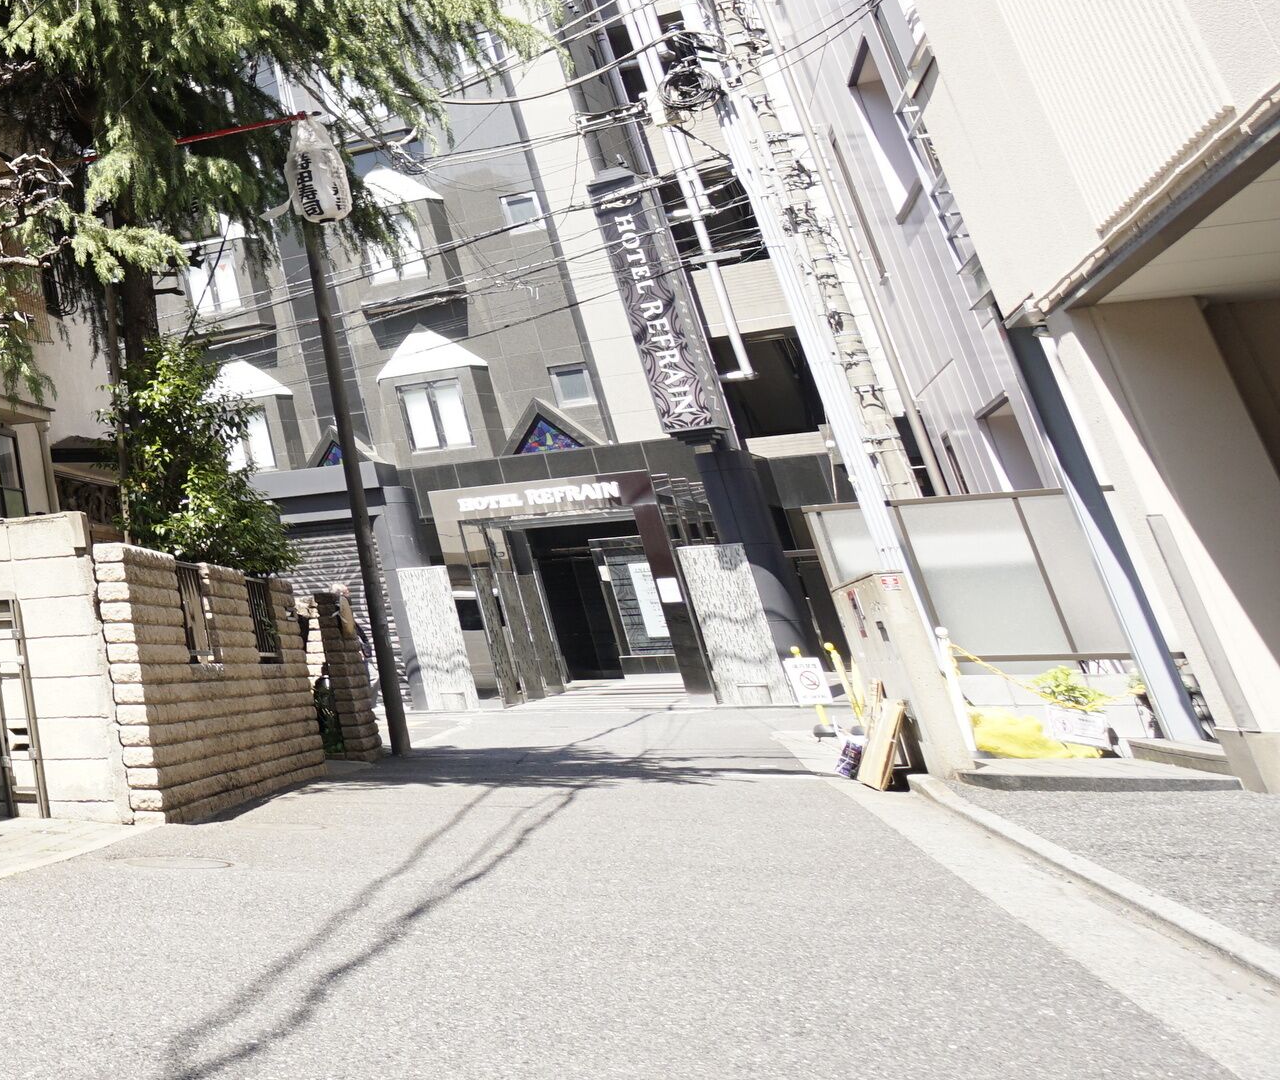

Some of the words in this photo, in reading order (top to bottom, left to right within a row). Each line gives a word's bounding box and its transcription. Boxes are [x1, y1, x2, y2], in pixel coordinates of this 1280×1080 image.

[614, 213, 656, 295] HOTEL
[640, 298, 699, 416] REFRAIN
[457, 493, 523, 512] HOTEL
[524, 481, 620, 506] REFRAIN
